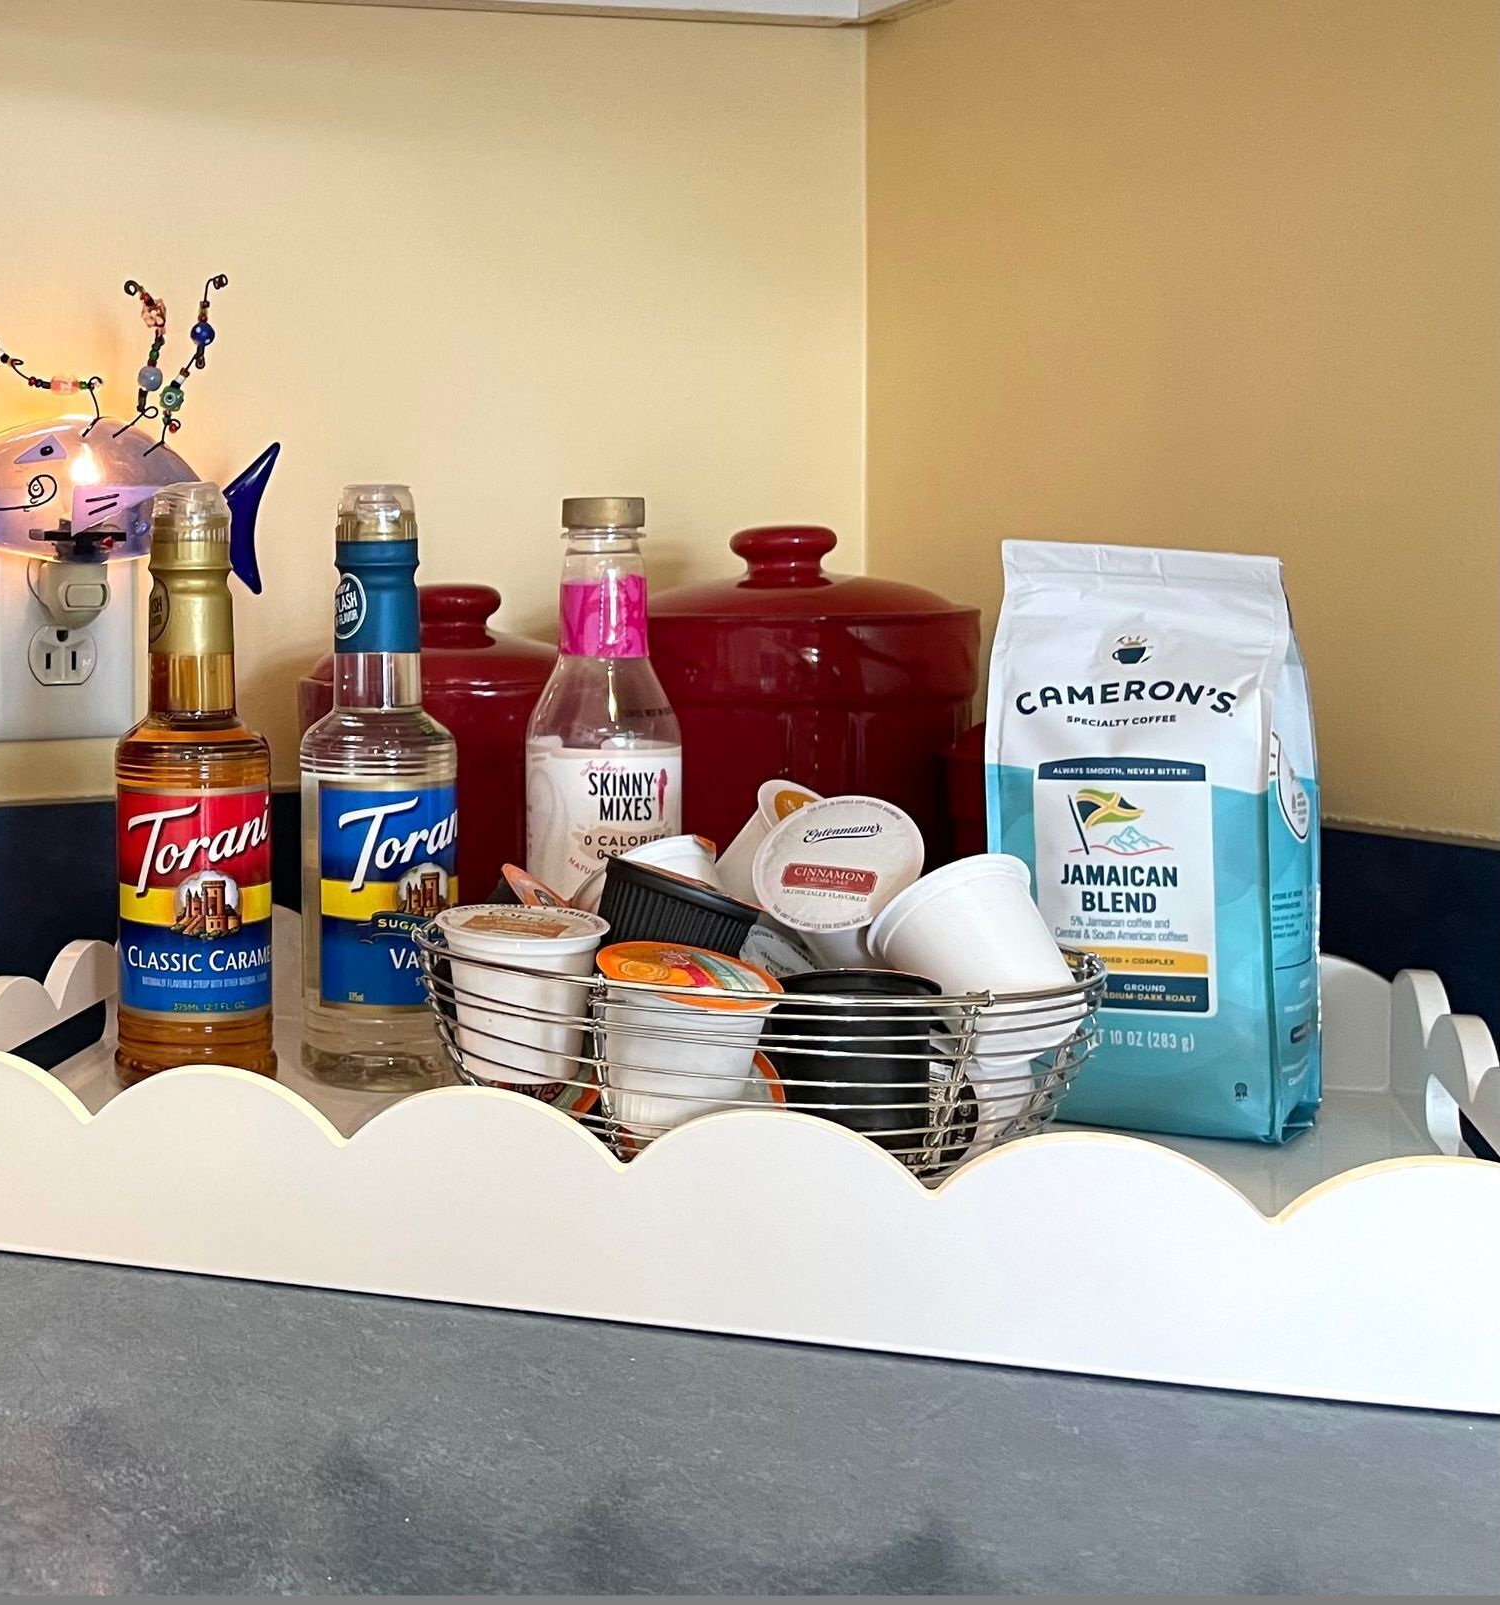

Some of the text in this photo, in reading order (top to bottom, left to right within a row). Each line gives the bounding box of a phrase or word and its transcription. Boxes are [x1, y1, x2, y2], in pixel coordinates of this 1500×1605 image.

[1015, 680, 1237, 715] CAMERON'S
[1066, 714, 1176, 728] SPECIALTY COFFEE
[1052, 767, 1084, 775] ALWAYS
[1085, 767, 1125, 776] SMOOTH,
[1126, 767, 1154, 775] NEVER
[588, 771, 655, 797] SKINNY
[599, 797, 652, 821] MIXES
[127, 795, 269, 894] Torani
[338, 796, 458, 891] Toran
[584, 835, 592, 846] 0
[794, 866, 866, 883] CINNAMON
[1060, 863, 1178, 888] JAMAICAN
[781, 888, 867, 902] ARTIFICIALLY FLAVORED
[1081, 890, 1157, 914] BLEND
[1070, 915, 1170, 929] 5% Jamaican coffee and
[1054, 926, 1189, 943] Central & South American coffees
[127, 944, 271, 972] CLASSIC CARAME
[1131, 957, 1175, 966] COMPLEX
[1123, 983, 1166, 992] GROUND
[1165, 994, 1197, 1003] ROAST
[1109, 1030, 1122, 1045] 10
[1126, 1030, 1144, 1047] OZ
[1147, 1031, 1177, 1049] (283
[1180, 1033, 1195, 1053] g)
